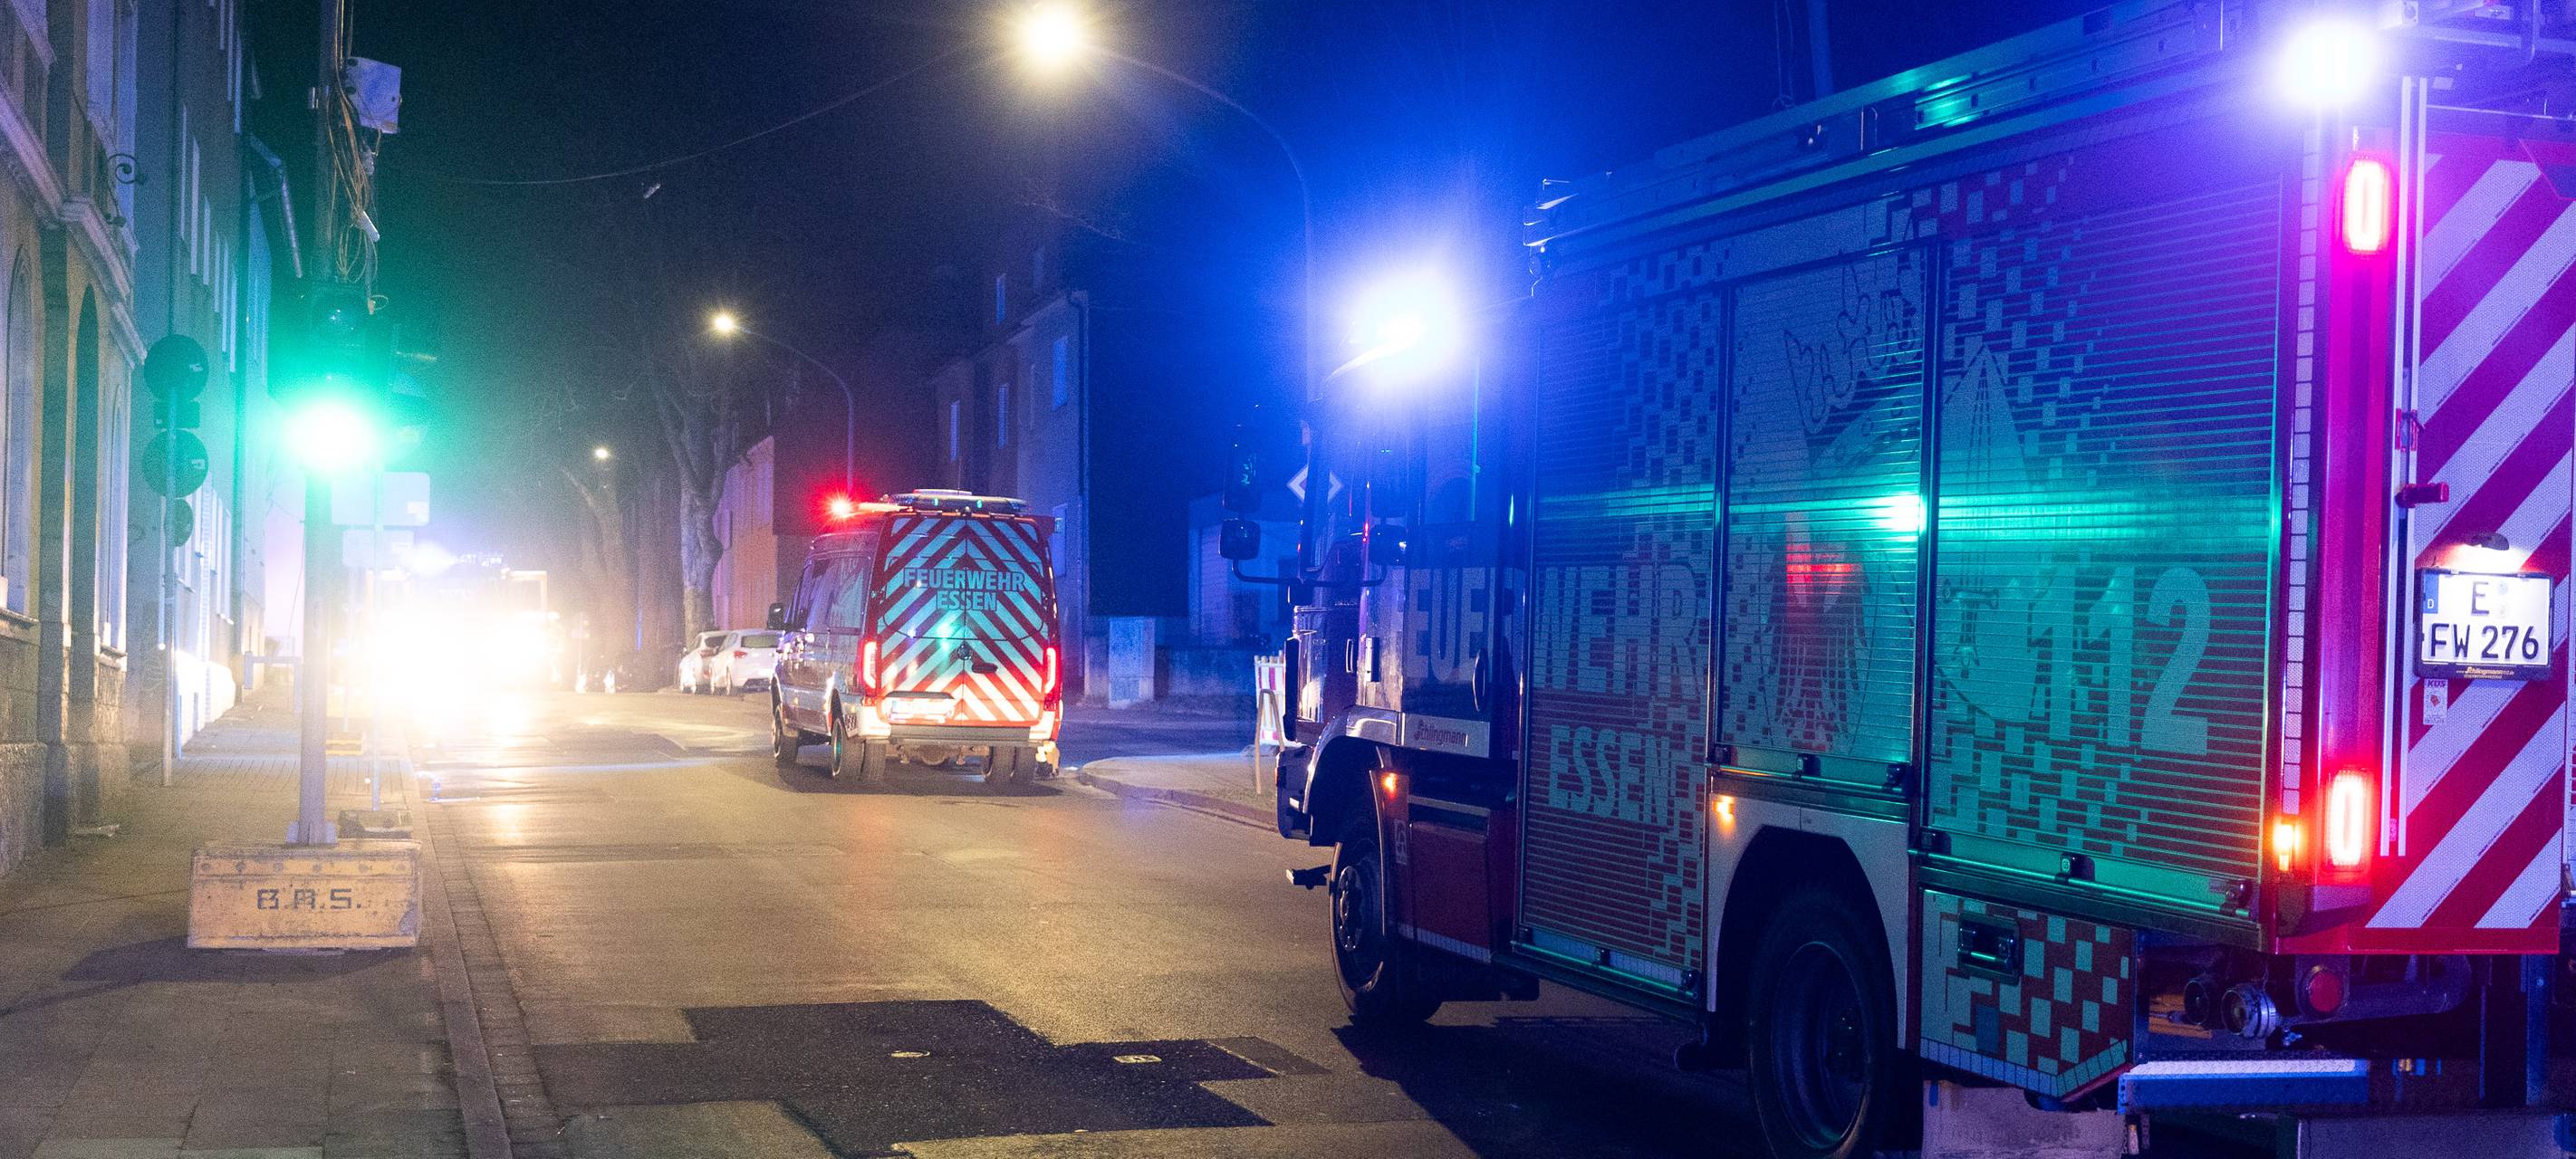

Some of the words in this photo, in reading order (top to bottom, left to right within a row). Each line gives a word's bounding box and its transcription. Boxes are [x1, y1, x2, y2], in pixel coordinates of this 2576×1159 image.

[904, 568, 1025, 591] FEUERWEHR
[937, 590, 996, 611] ESSEN
[2471, 581, 2489, 615] E
[2430, 623, 2471, 658] FW
[2481, 626, 2539, 659] 276
[2031, 565, 2211, 755] 112
[1545, 724, 1670, 827] ESSEN
